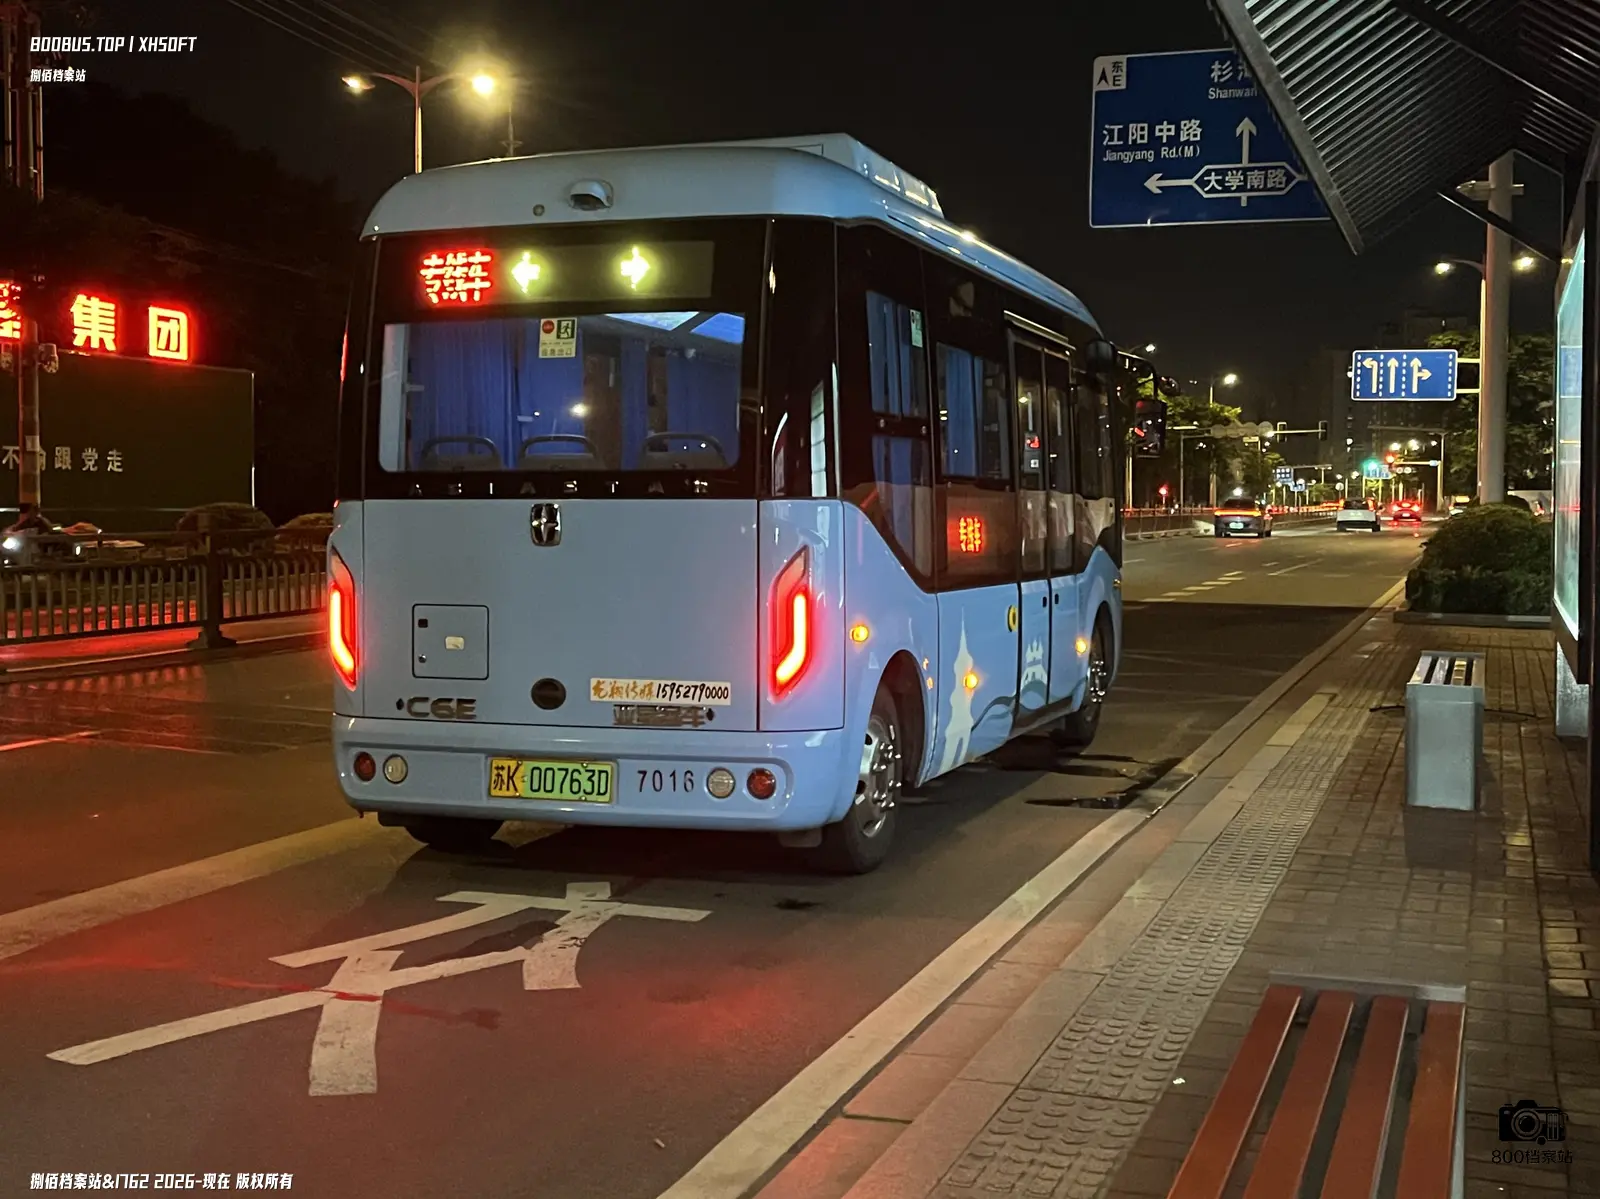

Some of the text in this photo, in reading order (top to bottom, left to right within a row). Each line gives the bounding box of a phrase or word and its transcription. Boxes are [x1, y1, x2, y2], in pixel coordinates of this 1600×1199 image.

[1111, 61, 1123, 73] 东
[1112, 75, 1122, 87] E
[1102, 118, 1202, 146] 江阳中路
[1102, 149, 1155, 164] Jiangyang
[1203, 168, 1287, 192] 大学南路
[1, 445, 124, 473] 不跟党走
[656, 682, 730, 703] 15952790000
[636, 770, 695, 793] 7016
[47, 881, 711, 1097] 交
